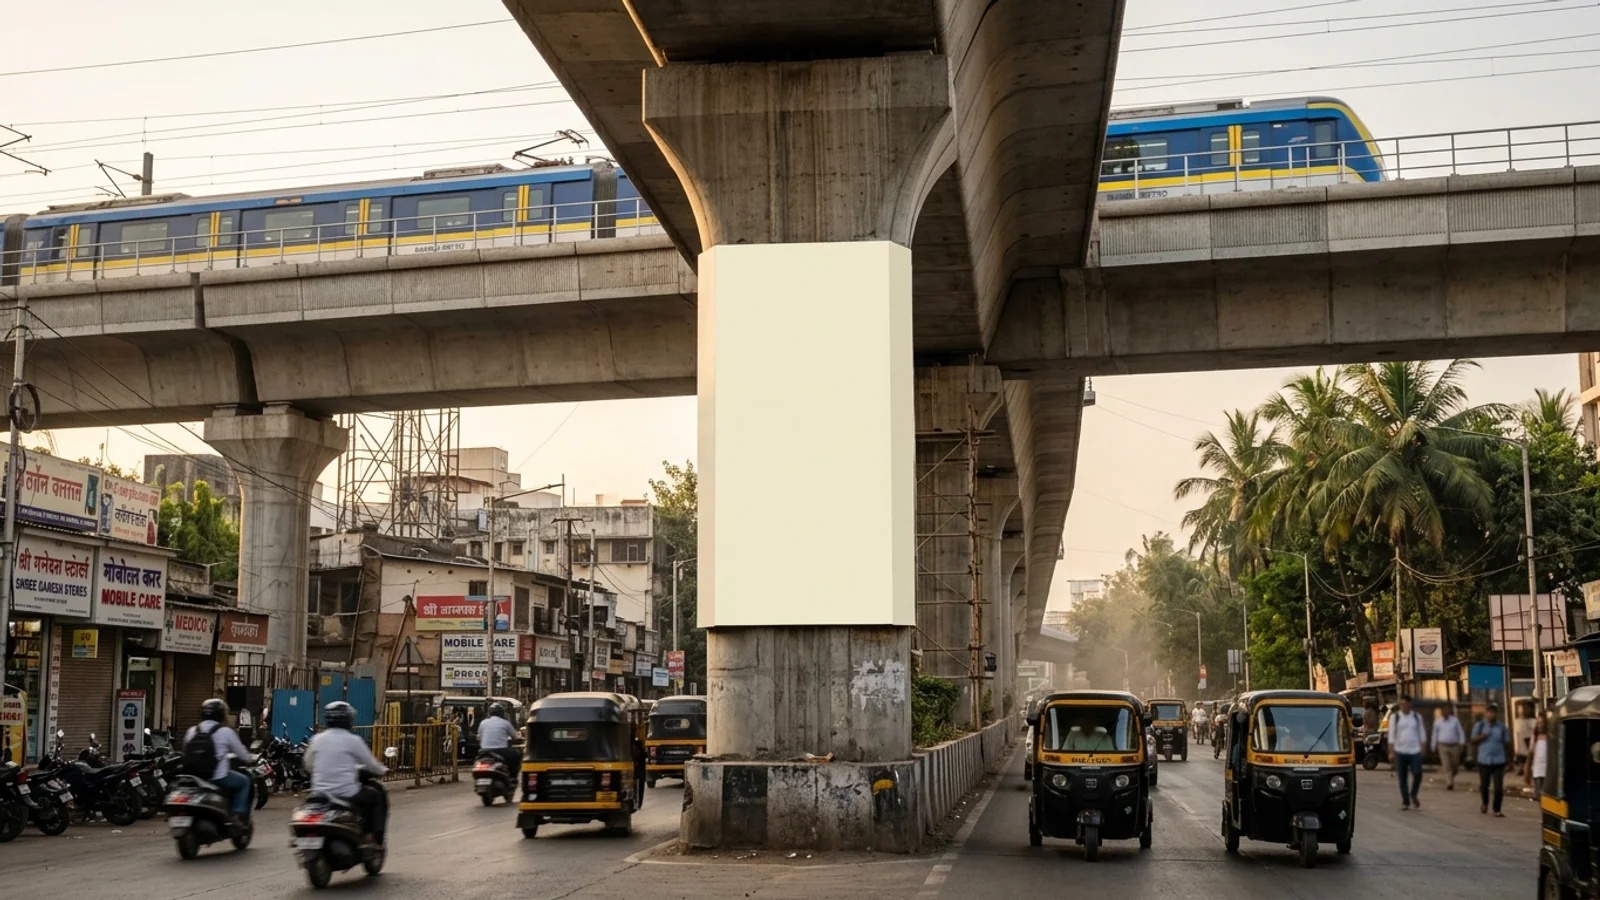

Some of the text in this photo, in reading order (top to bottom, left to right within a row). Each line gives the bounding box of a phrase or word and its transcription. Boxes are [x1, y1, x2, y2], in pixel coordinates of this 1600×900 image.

[101, 589, 162, 610] MOBILE CARE
[444, 638, 516, 648] MOBILE ARE
